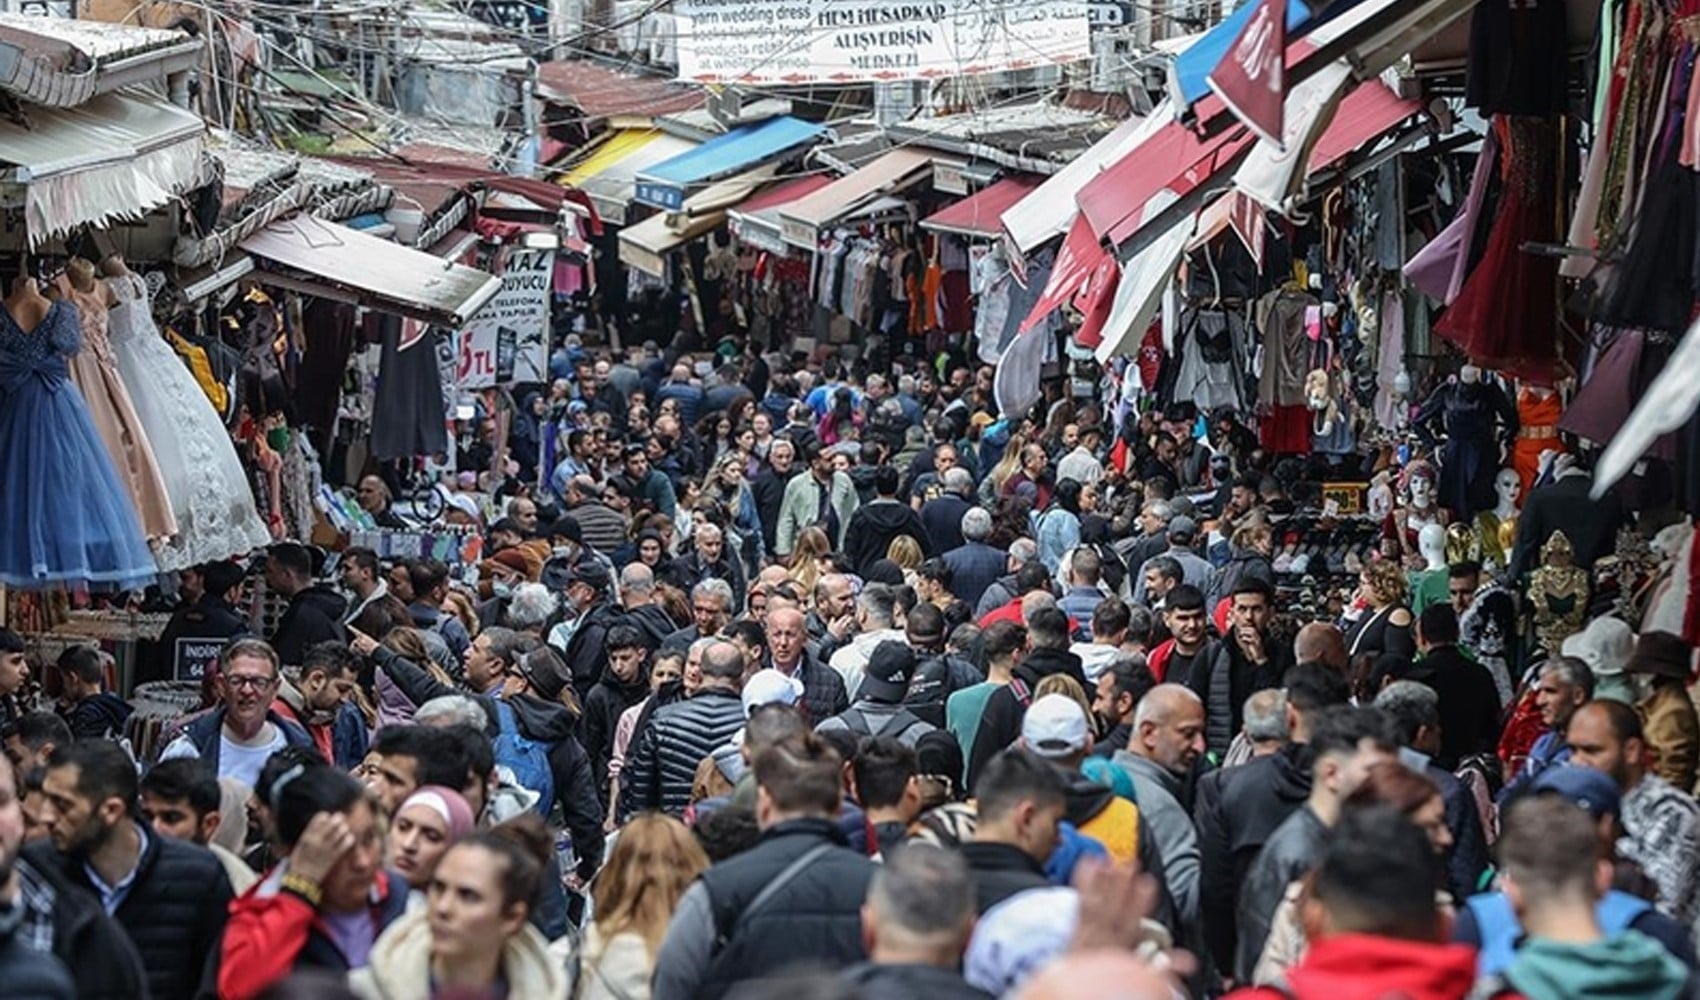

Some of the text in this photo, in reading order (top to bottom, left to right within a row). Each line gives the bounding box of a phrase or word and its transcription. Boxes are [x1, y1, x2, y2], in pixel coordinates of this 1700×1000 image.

[721, 7, 774, 25] wedding
[776, 5, 811, 20] dress
[818, 10, 854, 26] HEM
